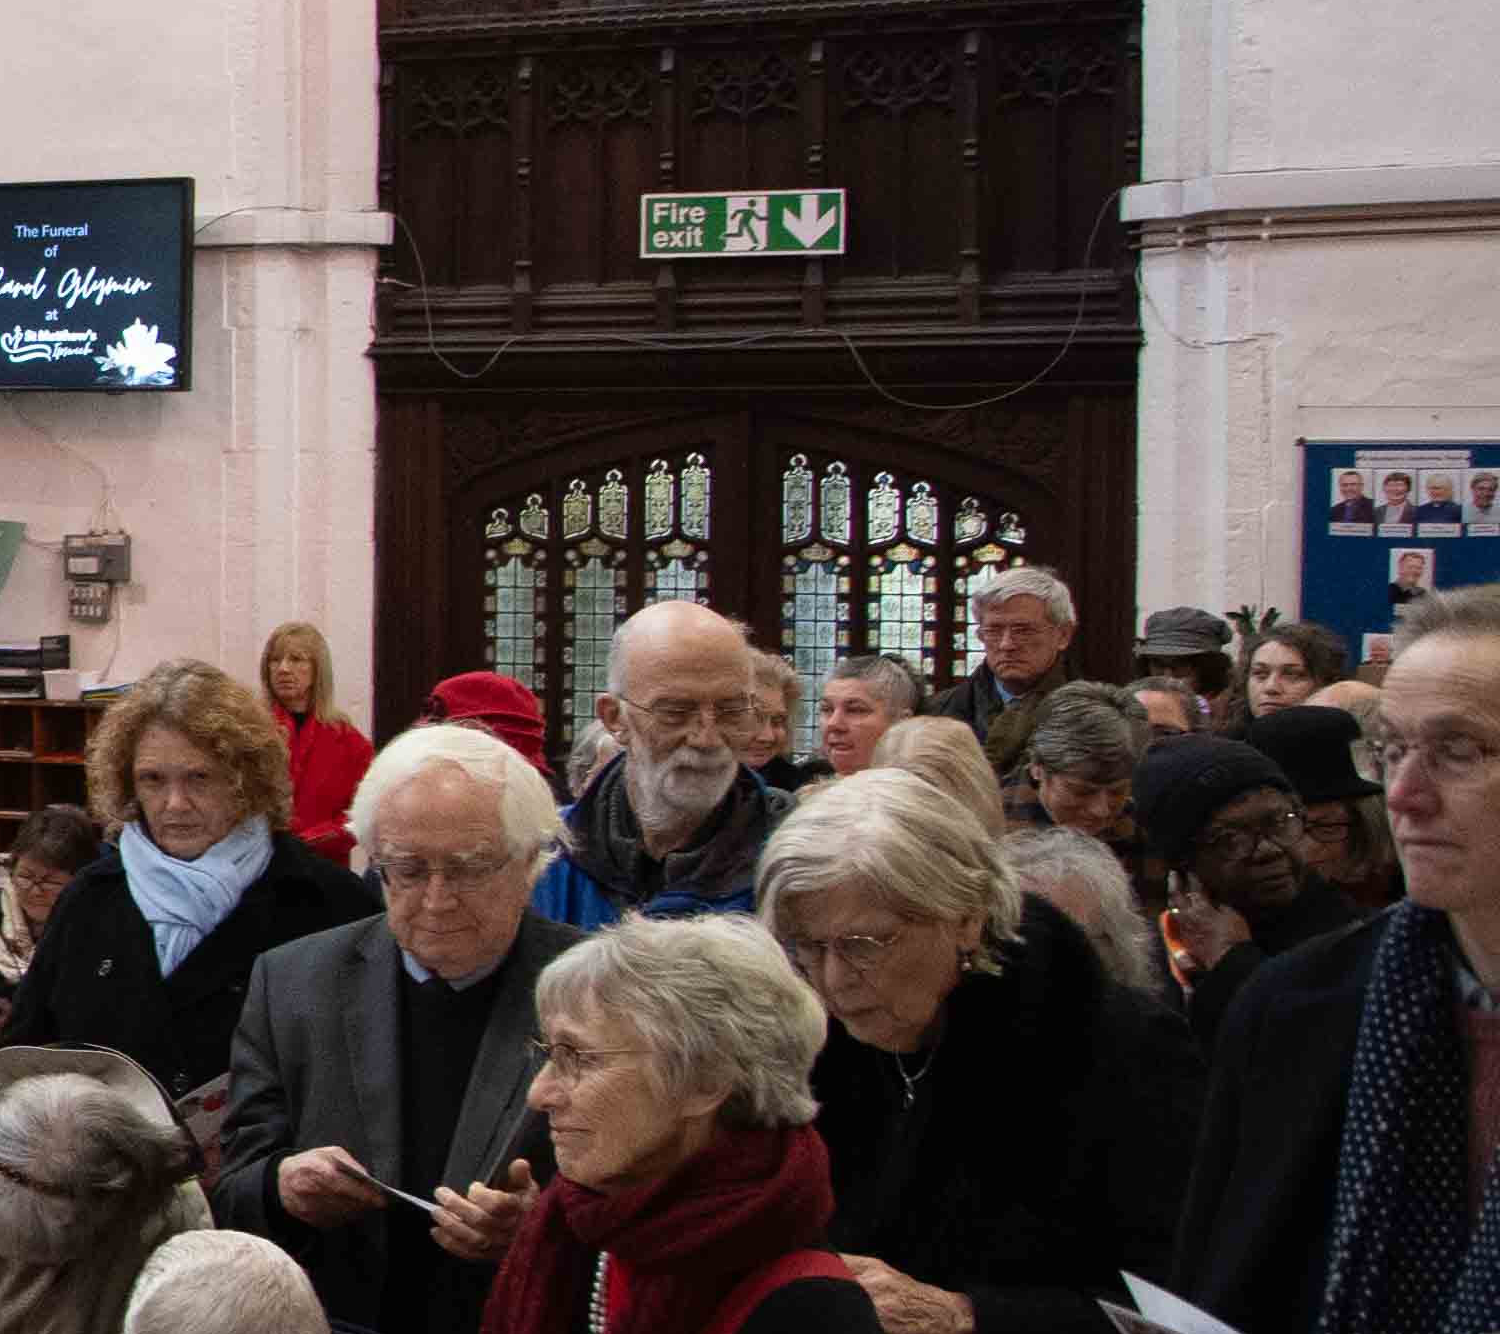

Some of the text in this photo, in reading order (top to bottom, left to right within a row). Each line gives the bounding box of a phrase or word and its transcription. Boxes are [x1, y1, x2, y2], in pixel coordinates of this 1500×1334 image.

[653, 202, 707, 224] Fire
[14, 222, 88, 239] The Funeral
[652, 226, 704, 248] exit
[44, 244, 59, 258] of
[45, 308, 59, 321] at
